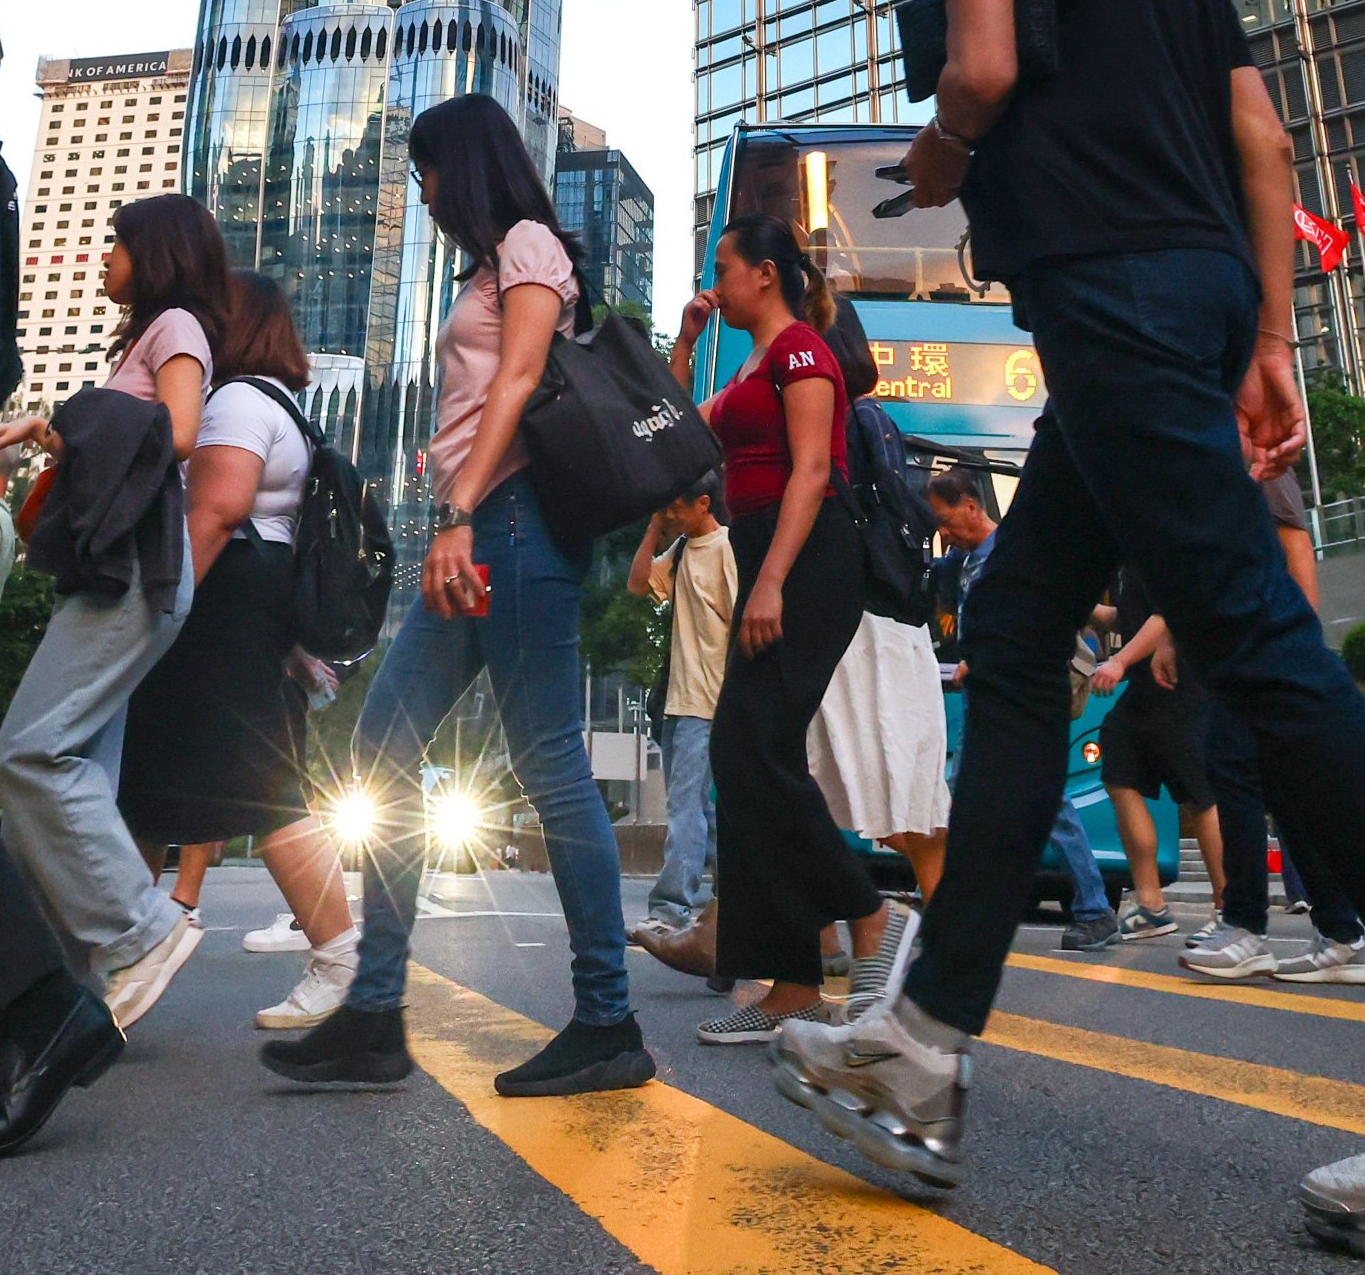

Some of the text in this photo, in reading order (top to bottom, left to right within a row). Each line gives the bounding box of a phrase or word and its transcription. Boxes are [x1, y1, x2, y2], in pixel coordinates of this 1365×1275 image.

[86, 66, 103, 77] OF
[105, 61, 167, 75] AMERICA
[788, 350, 815, 370] AN
[869, 341, 950, 377] 中環
